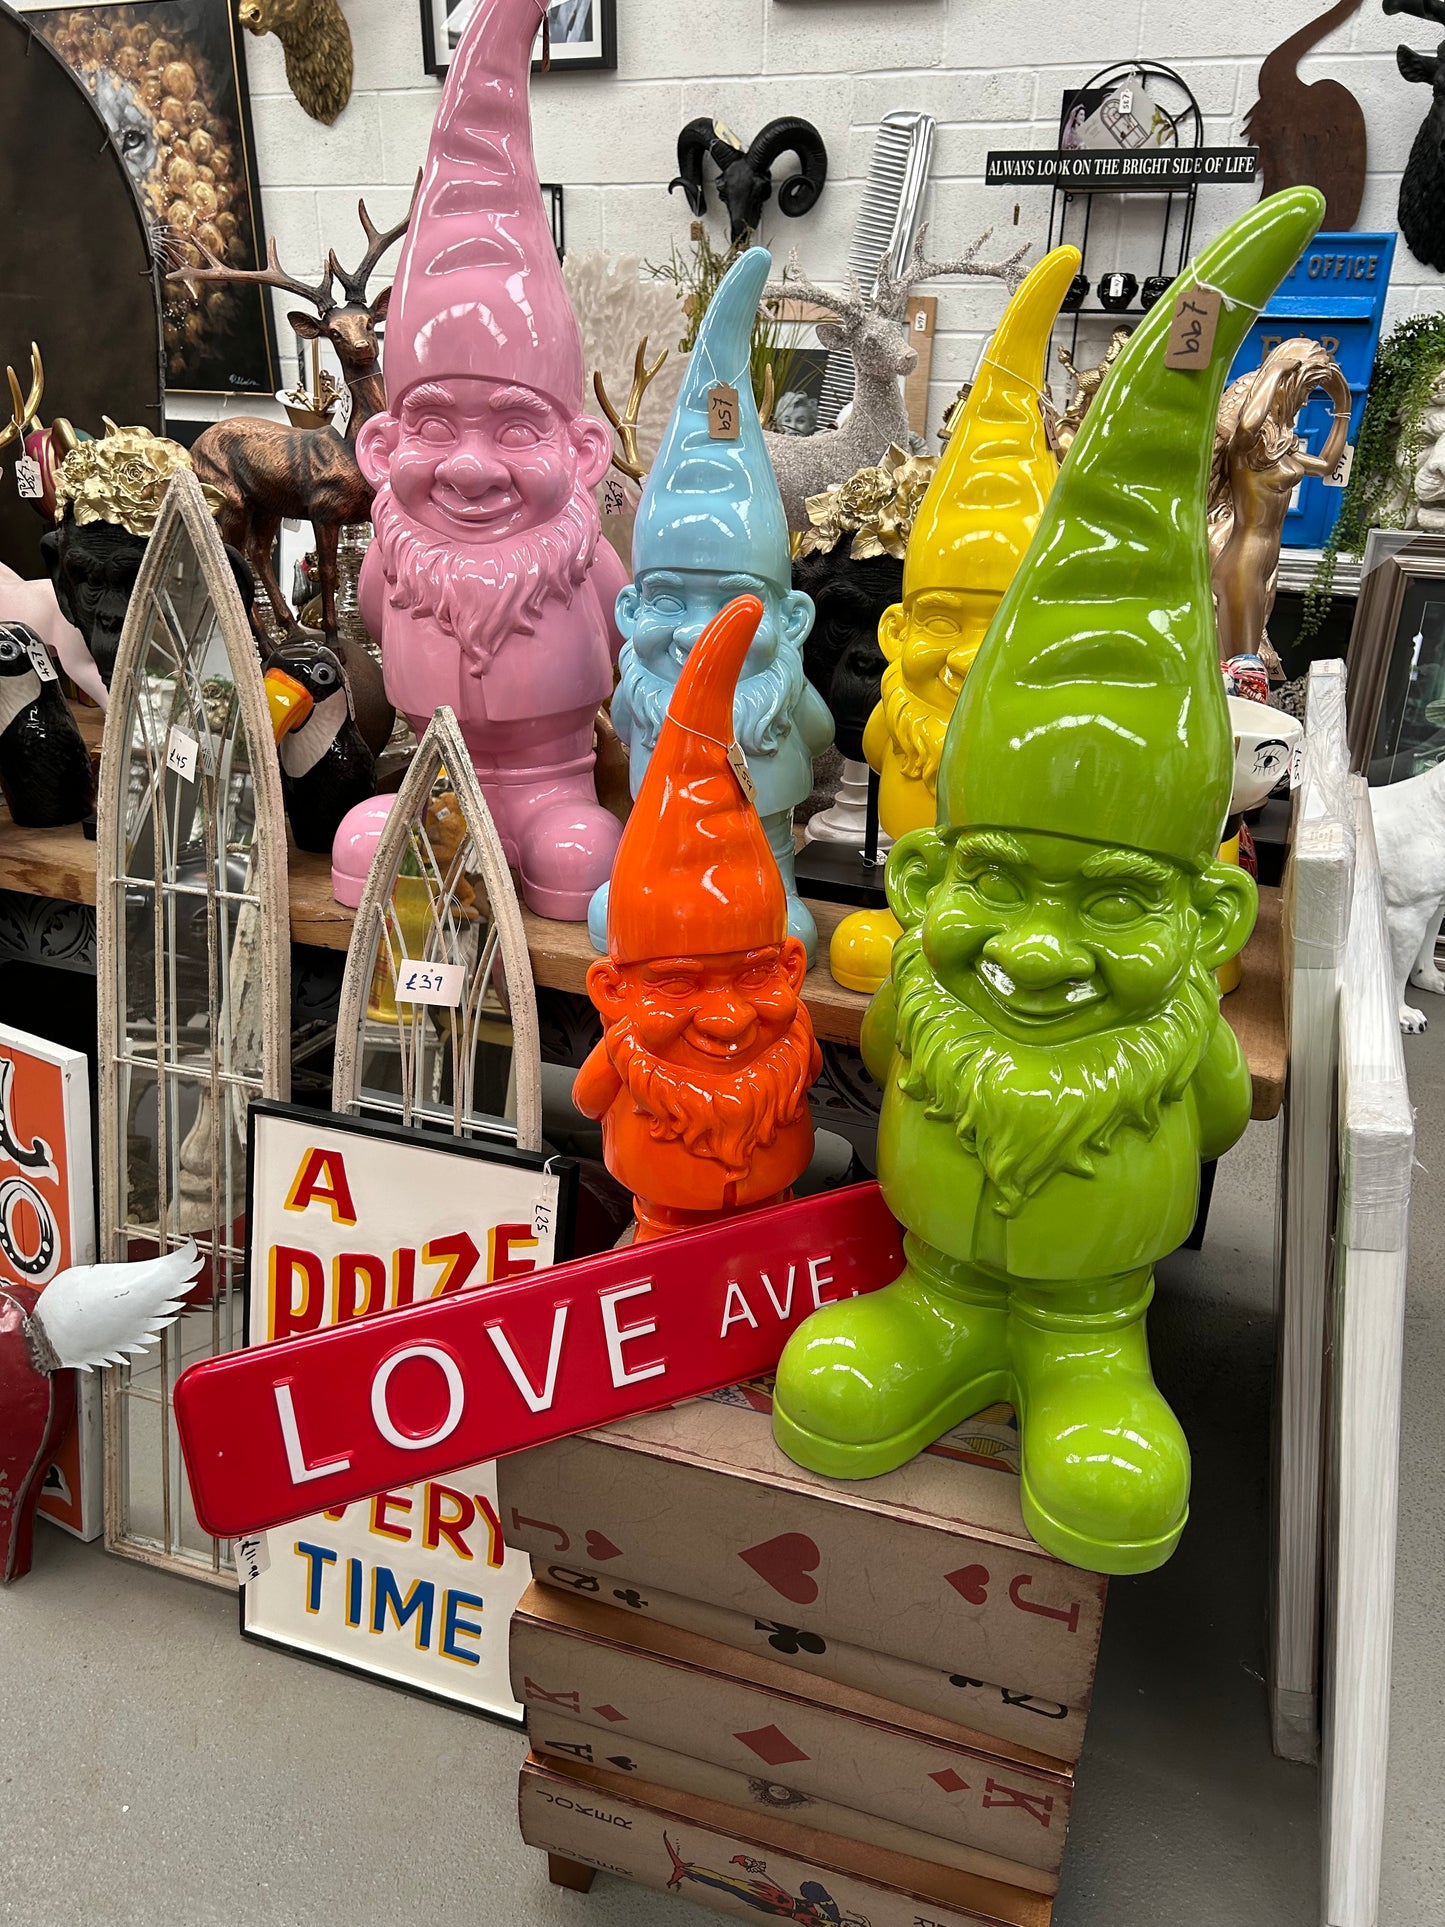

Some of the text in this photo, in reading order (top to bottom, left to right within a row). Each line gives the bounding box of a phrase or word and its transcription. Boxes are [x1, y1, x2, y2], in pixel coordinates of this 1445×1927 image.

[988, 156, 1255, 176] ALWAYS LOOK ON THE BRIGHT SIDE OF LIFE
[1308, 254, 1378, 280] OFFICE
[1173, 301, 1208, 355] £99
[712, 397, 733, 431] £59
[31, 651, 50, 677] £24
[170, 748, 188, 769] £45
[406, 973, 443, 992] £39
[283, 1147, 357, 1226] A
[535, 1204, 551, 1233] £25
[274, 1282, 666, 1484] LOVE
[511, 1507, 570, 1552] J
[294, 1541, 484, 1666] TIME
[1009, 1574, 1081, 1633] J
[524, 1676, 580, 1714] K
[544, 1740, 593, 1763] A
[536, 1789, 633, 1830] JOKER
[982, 1776, 1054, 1828] K
